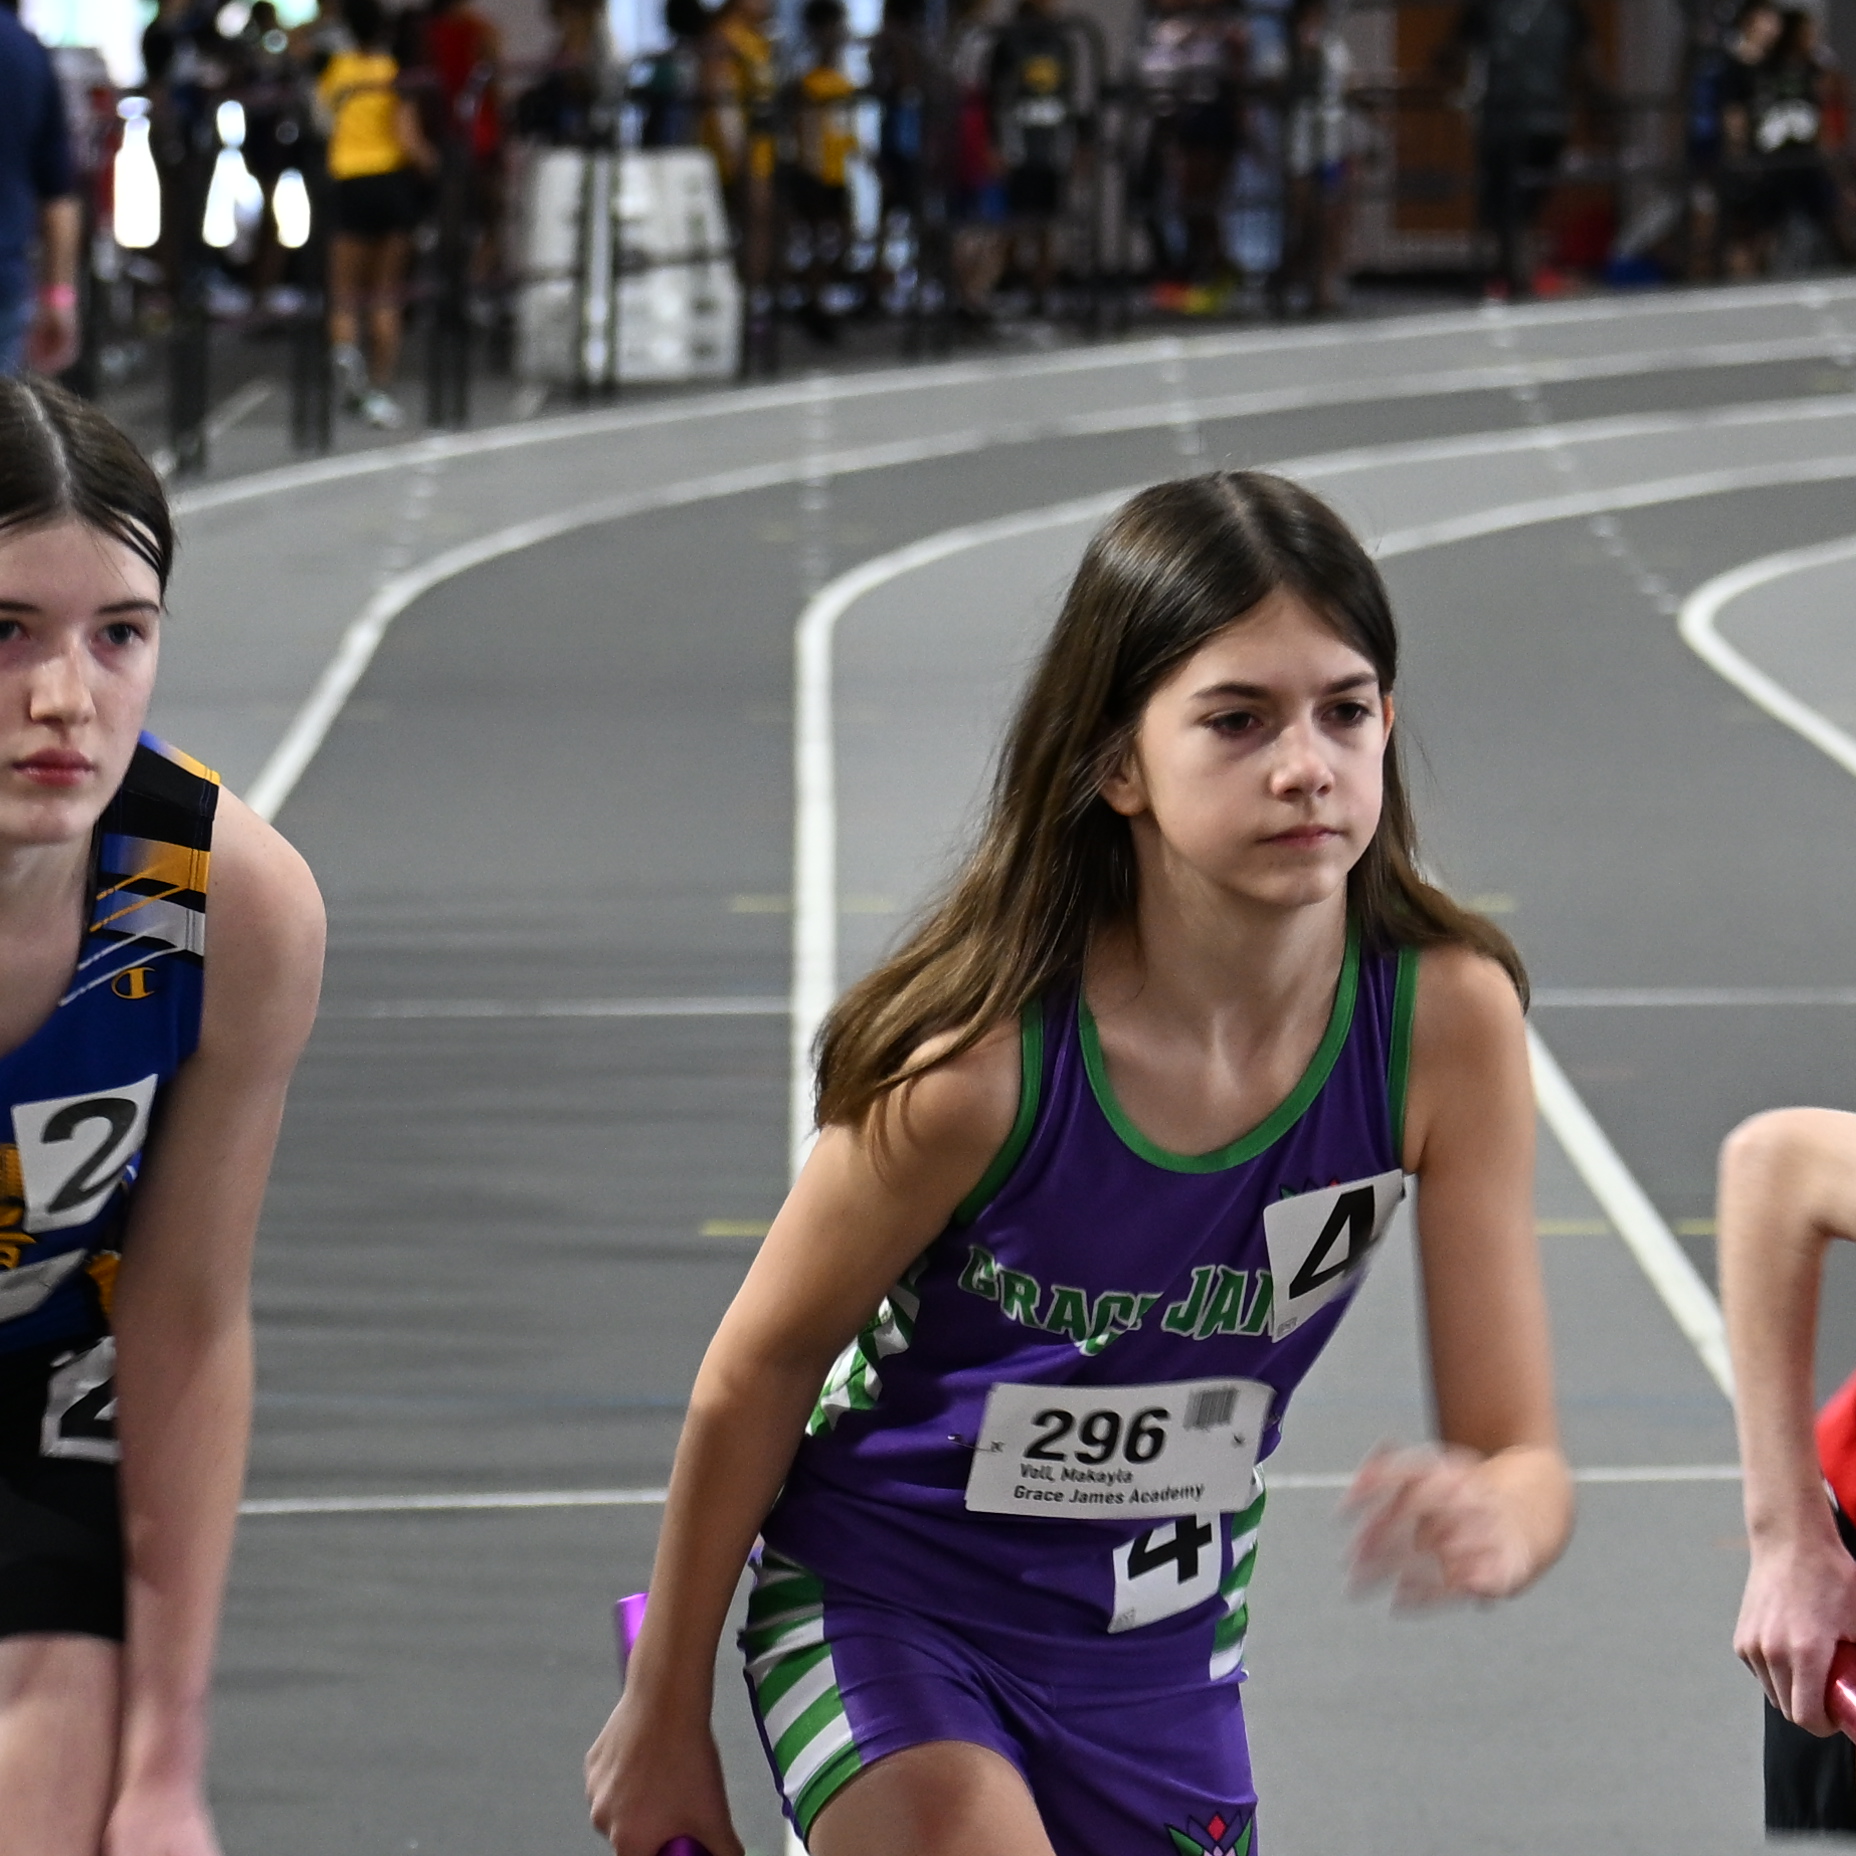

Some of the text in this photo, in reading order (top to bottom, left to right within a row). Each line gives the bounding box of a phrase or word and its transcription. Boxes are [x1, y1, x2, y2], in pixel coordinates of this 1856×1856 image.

[40, 1097, 137, 1214] 2
[1288, 1185, 1375, 1299] 4
[1022, 1404, 1170, 1465] 296
[1013, 1482, 1205, 1504] Grace James Academy
[1060, 1466, 1133, 1487] Makayla
[1127, 1512, 1212, 1584] 4
